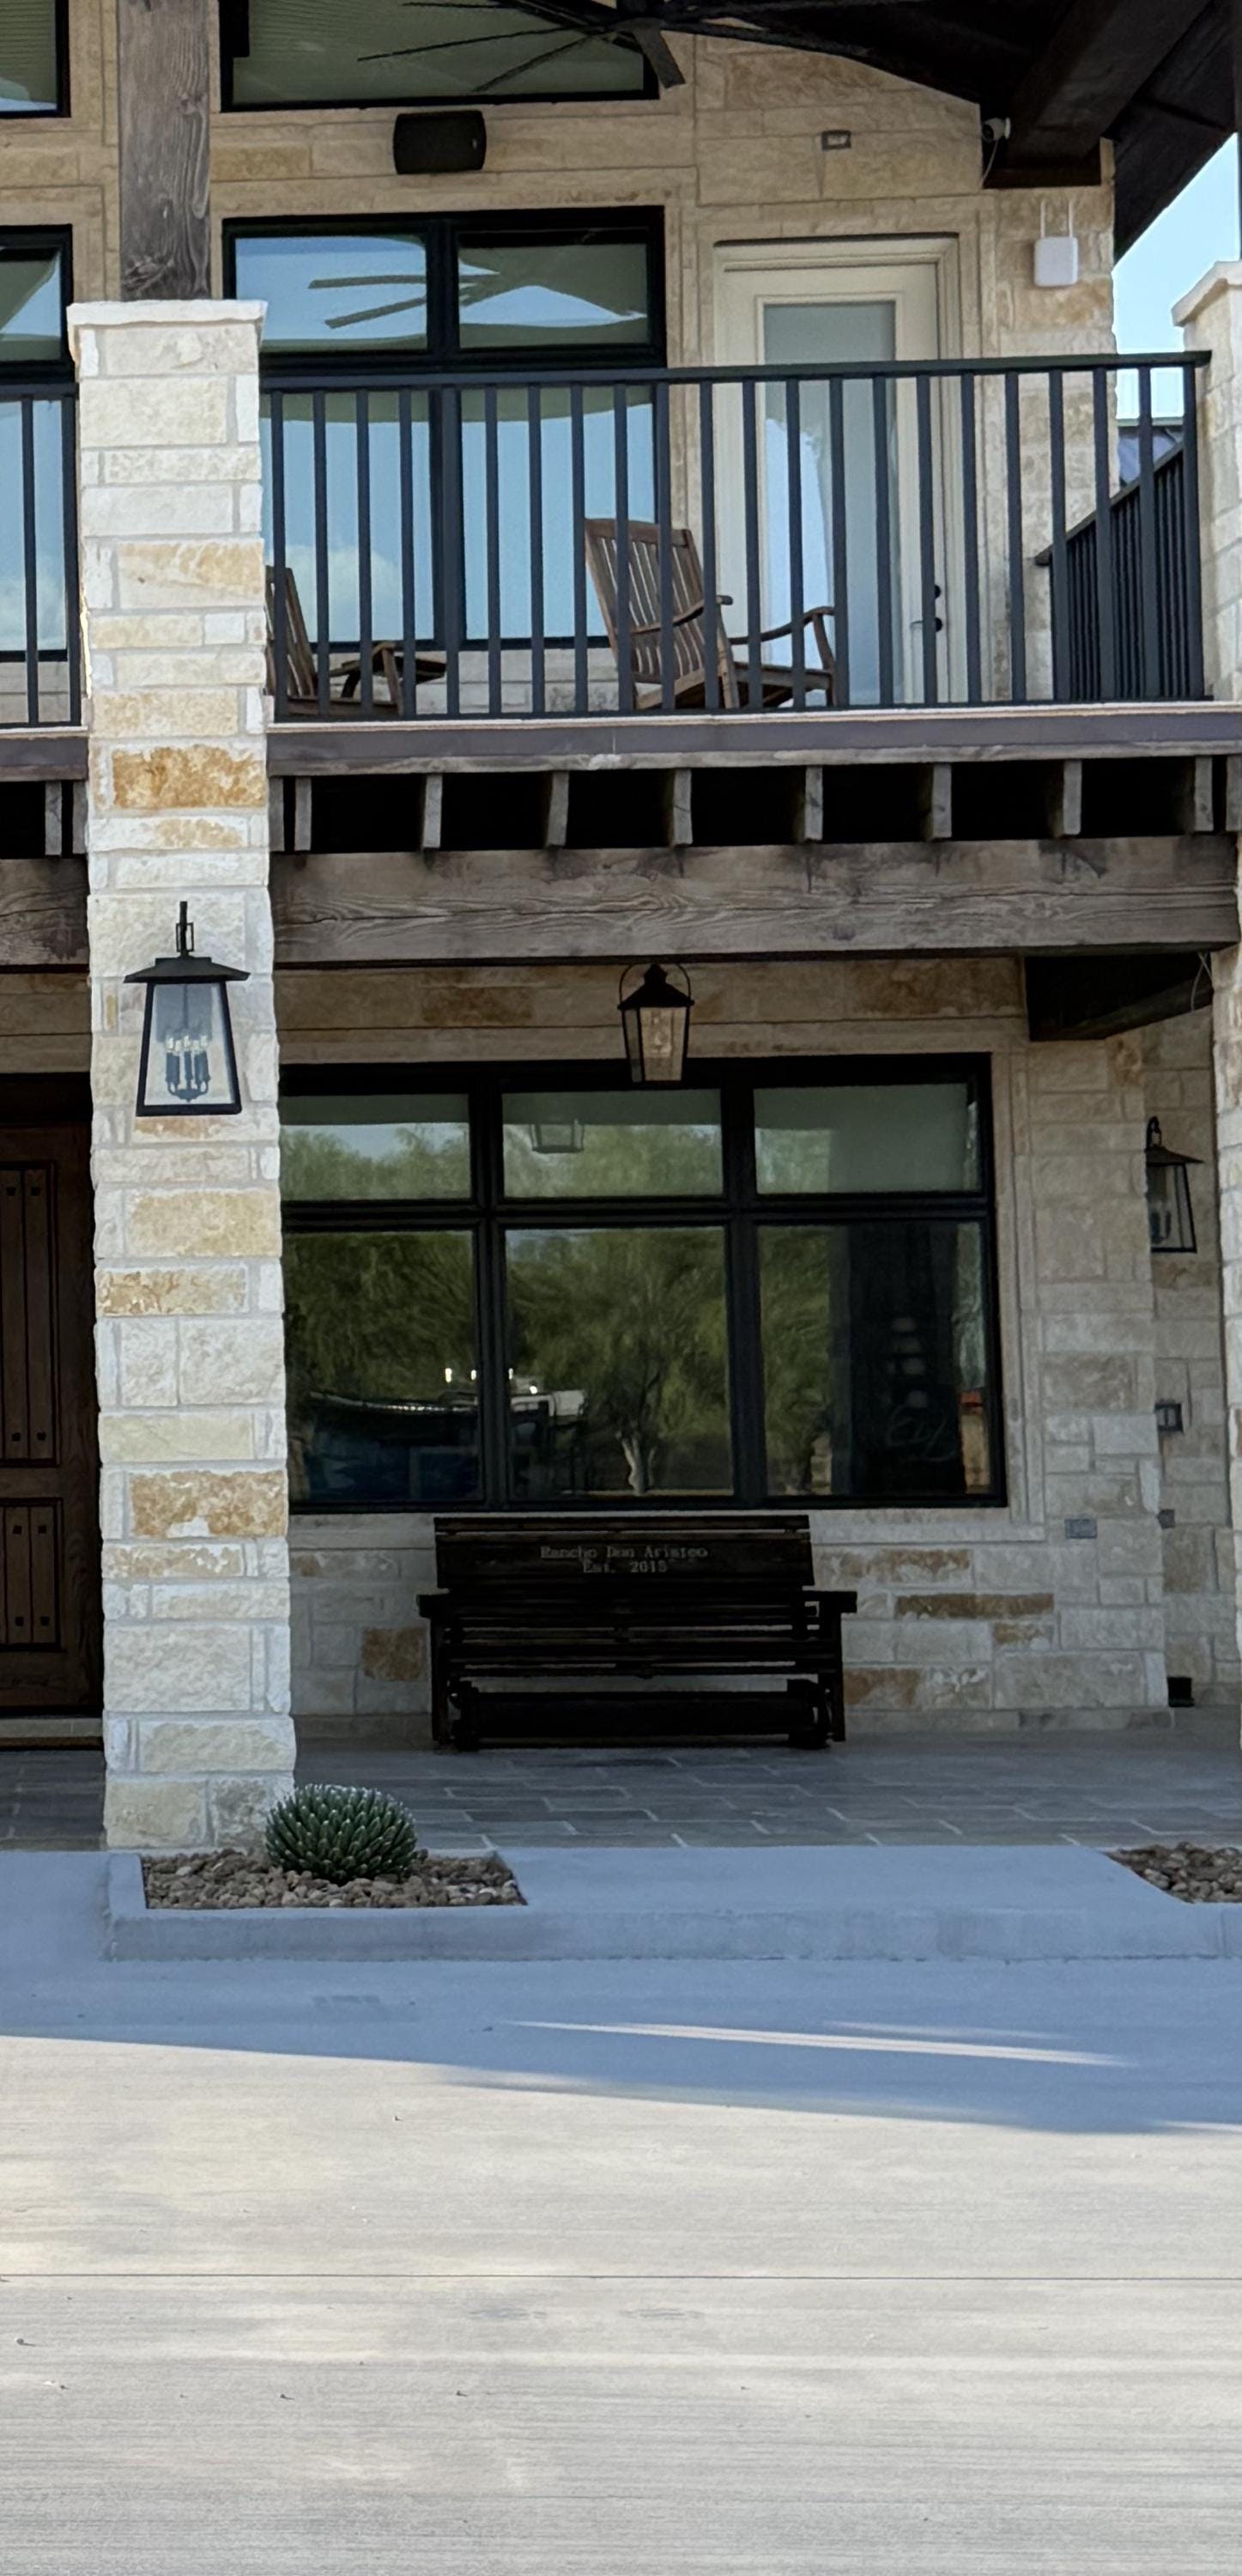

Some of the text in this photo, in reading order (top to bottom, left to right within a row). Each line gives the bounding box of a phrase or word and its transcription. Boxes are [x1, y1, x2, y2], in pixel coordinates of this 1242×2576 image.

[541, 1545, 597, 1558] Rancho
[607, 1546, 635, 1558] Don
[583, 1559, 616, 1573] Est.
